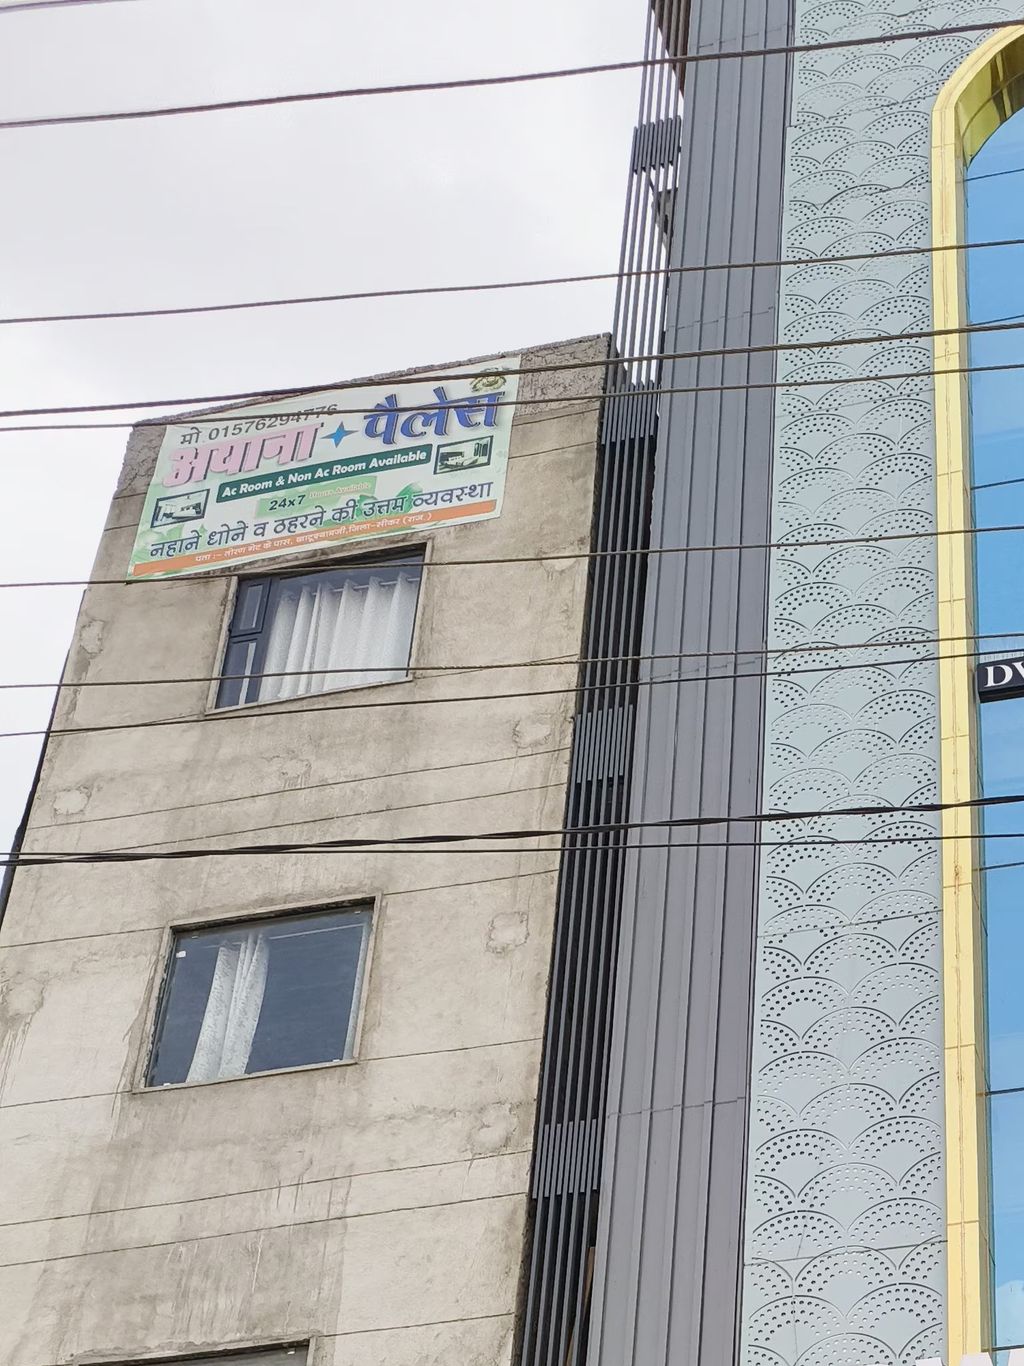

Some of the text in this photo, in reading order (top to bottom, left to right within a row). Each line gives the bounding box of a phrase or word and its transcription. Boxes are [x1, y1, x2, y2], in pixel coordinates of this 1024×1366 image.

[364, 386, 506, 445] पैलेस
[222, 450, 427, 498] Ac Room & Non Ac Room Available
[150, 481, 494, 557] नहाने धोने व ठहरने की उत्तम व्यवस्था
